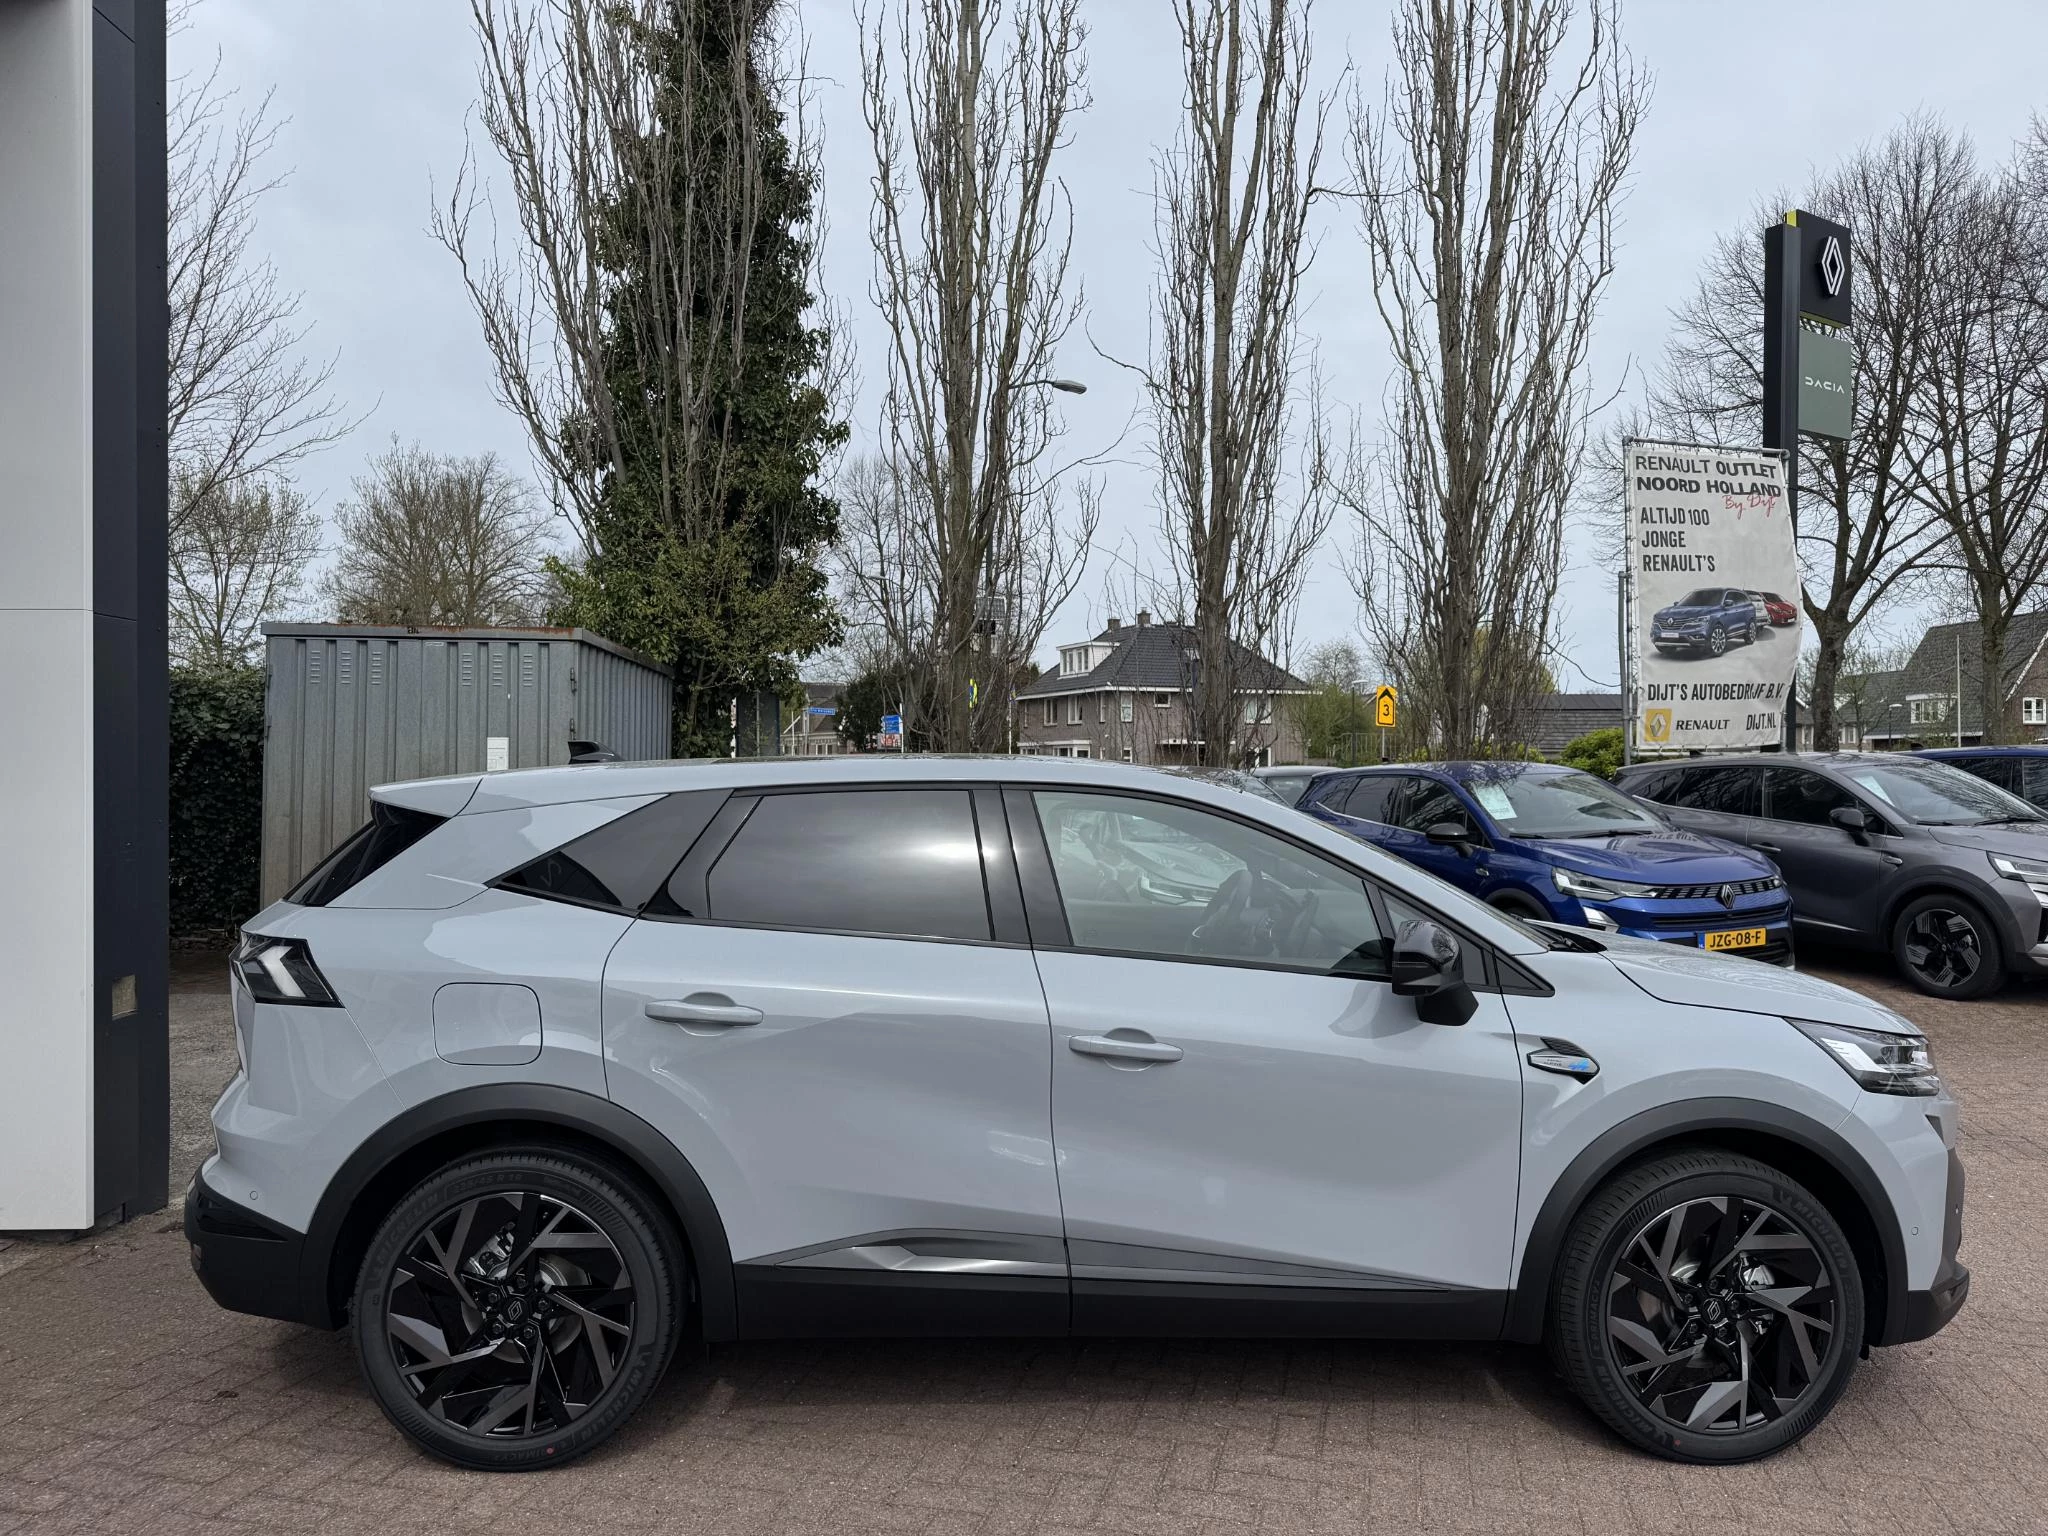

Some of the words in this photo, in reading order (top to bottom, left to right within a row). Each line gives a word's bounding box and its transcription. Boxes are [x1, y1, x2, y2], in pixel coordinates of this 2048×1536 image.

[1804, 376, 1845, 394] DACIA
[1635, 455, 1710, 473] RENAULT
[1716, 460, 1776, 479] OUTLET
[1637, 476, 1700, 493] NOORD
[1707, 480, 1781, 497] HOLLAND
[1640, 507, 1686, 525] ALTIJD
[1688, 509, 1710, 525] 100
[1722, 494, 1743, 520] By
[1641, 530, 1686, 548] JONGE
[1643, 554, 1715, 572] RENAULT'S
[1647, 683, 1688, 701] DIJT'S
[1691, 683, 1765, 701] AUTOBEDRIJF
[1383, 704, 1390, 716] 3
[1676, 719, 1730, 731] RENAULT
[1745, 712, 1777, 731] DIJT.NL
[1710, 931, 1761, 947] JZG-08-F
